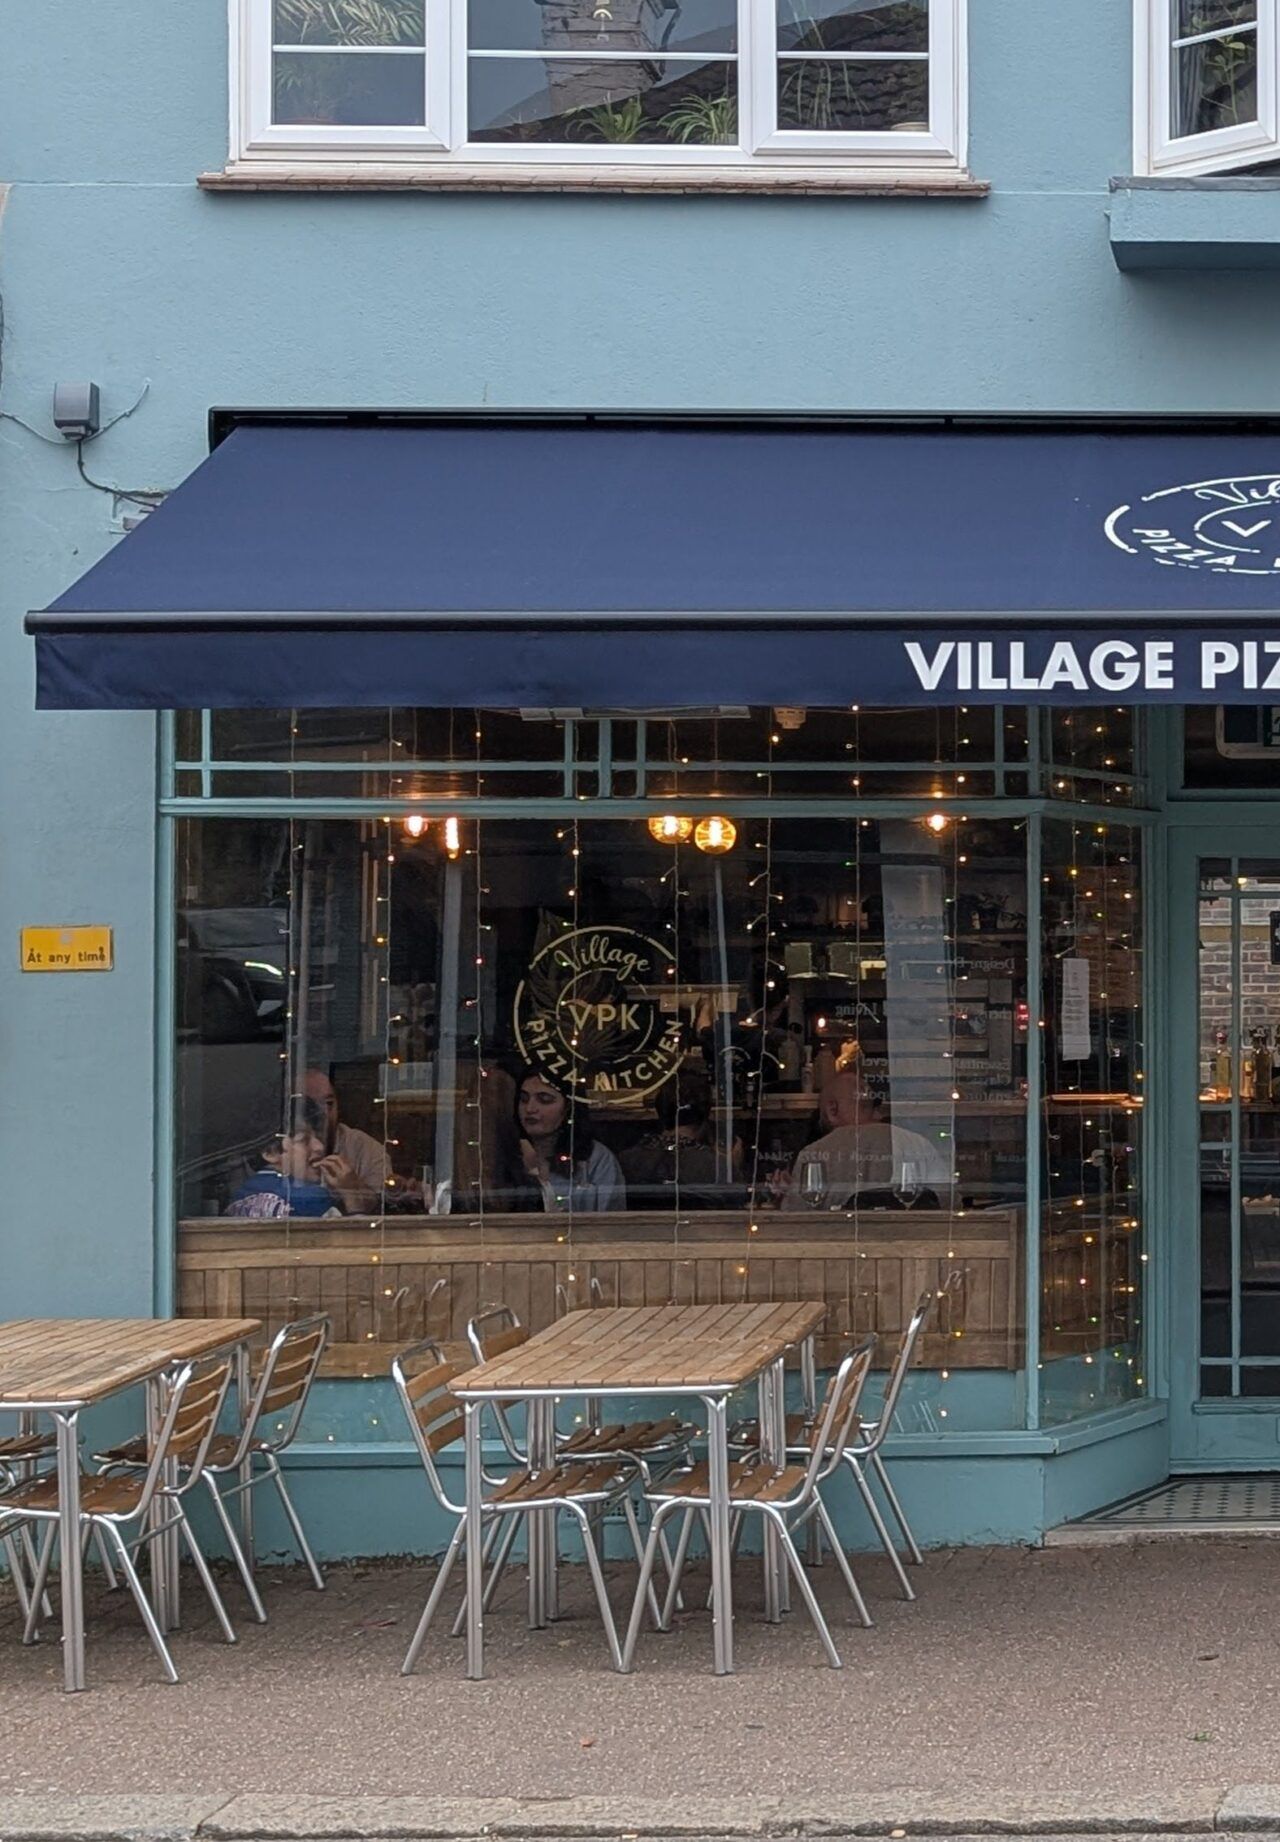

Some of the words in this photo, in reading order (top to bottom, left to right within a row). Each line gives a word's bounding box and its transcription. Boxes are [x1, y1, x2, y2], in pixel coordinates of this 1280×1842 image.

[1132, 527, 1236, 567] PIZZA
[903, 639, 1175, 692] VILLAGE
[27, 951, 42, 963] At
[48, 953, 71, 964] any
[78, 950, 106, 963] time
[553, 934, 651, 982] Village
[568, 1004, 641, 1031] VPK
[526, 1018, 579, 1087] PIZZA
[593, 1019, 684, 1092] KITCHEN
